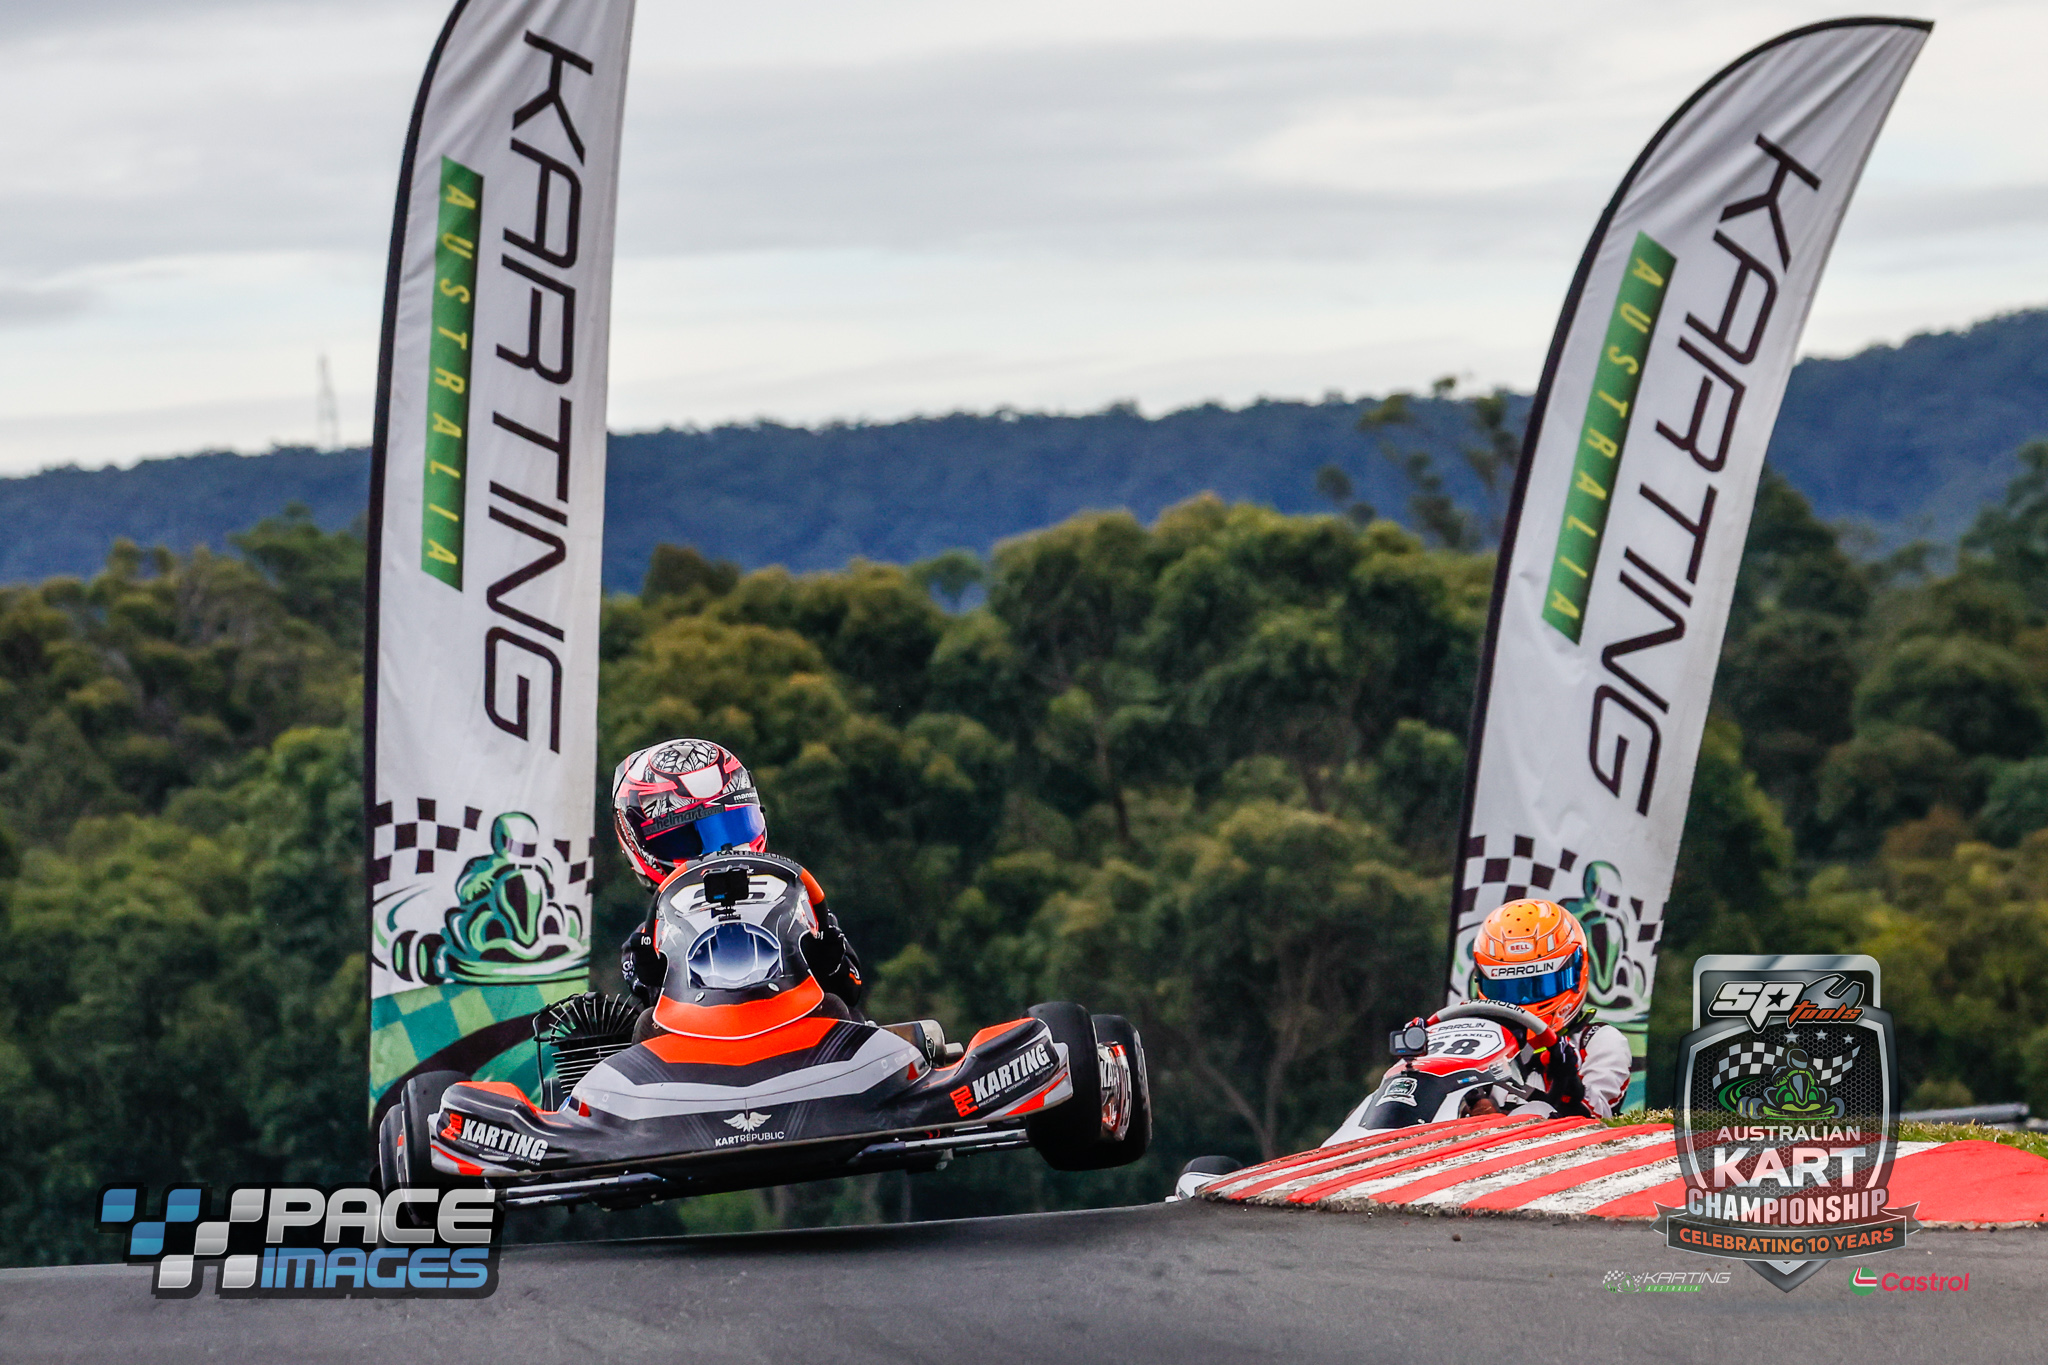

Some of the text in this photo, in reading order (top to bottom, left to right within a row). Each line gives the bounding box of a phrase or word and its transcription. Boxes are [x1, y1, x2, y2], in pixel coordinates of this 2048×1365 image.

[427, 184, 476, 565] AUSTRALIA
[485, 30, 594, 755] KARTING
[1551, 256, 1665, 621] AUSTRALIA
[1589, 133, 1822, 817] KARTING
[461, 1118, 548, 1162] KARTING
[972, 1043, 1051, 1103] KARTING
[1004, 1076, 1031, 1093] MOTORSPORT
